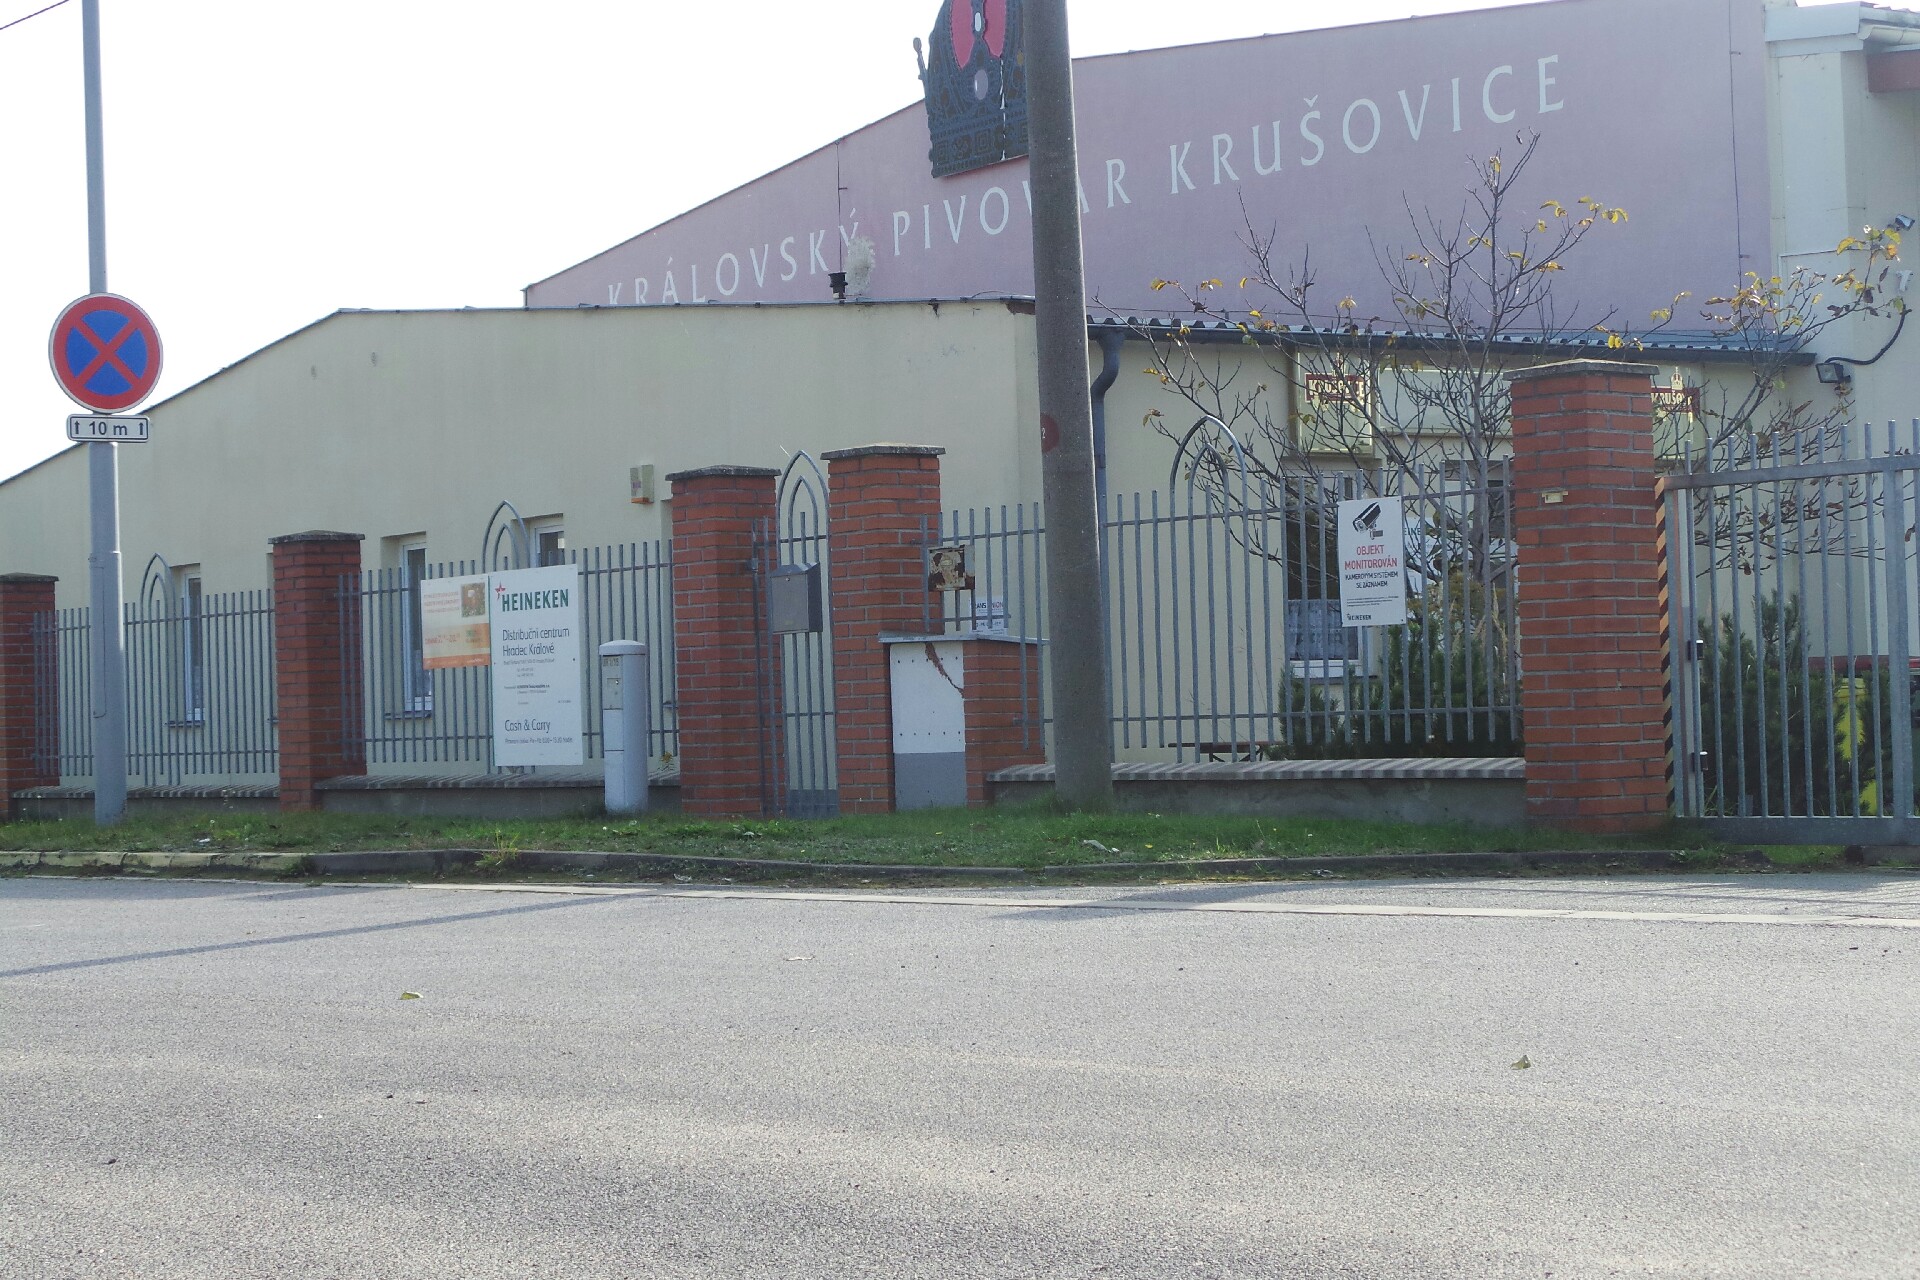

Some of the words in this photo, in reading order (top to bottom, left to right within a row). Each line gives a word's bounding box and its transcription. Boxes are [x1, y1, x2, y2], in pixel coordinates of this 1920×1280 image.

[892, 157, 1132, 256] PIVOR
[1169, 54, 1565, 195] KRUŠOVICE
[88, 421, 107, 436] 10
[113, 424, 128, 436] m
[1356, 544, 1385, 556] OBJEKT
[1344, 555, 1398, 570] MONITOROVÁN
[502, 589, 569, 612] HEINEKEN
[502, 628, 539, 641] Distribuční
[540, 627, 570, 639] centrum
[502, 644, 528, 656] Hradec
[528, 642, 555, 656] Králové
[504, 719, 522, 732] Cash
[523, 718, 531, 731] &
[531, 718, 551, 734] Carry
